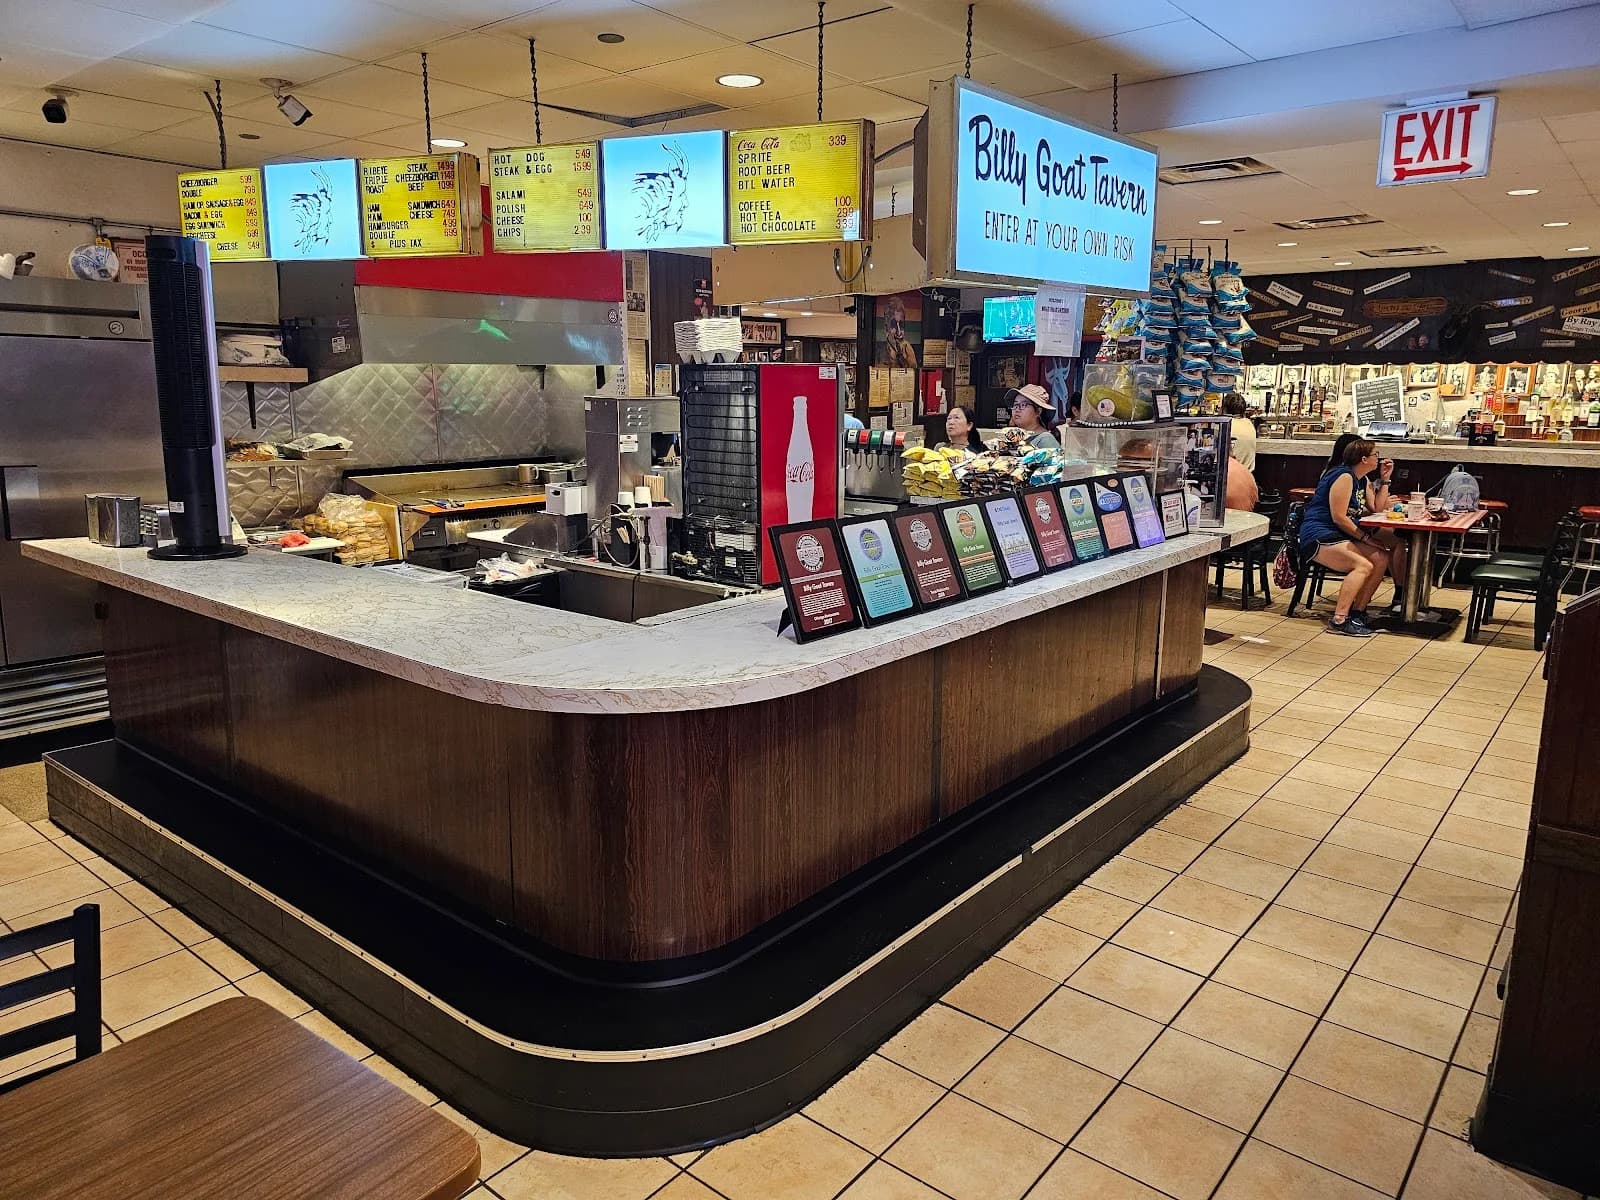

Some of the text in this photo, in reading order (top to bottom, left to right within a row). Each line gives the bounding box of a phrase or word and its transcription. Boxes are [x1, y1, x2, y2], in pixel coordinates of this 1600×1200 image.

[828, 134, 846, 146] 339
[1394, 104, 1480, 165] EXIT
[494, 149, 590, 164] HOT DOG 549
[738, 152, 772, 164] SPRITE
[364, 161, 454, 176] RIBEYE STEAK 1499
[494, 162, 592, 176] STEAK & EGG 1599
[738, 164, 790, 176] ROOT BEER
[968, 114, 1148, 216] Billy Goat Tavern
[364, 176, 388, 184] TRIPLE
[738, 177, 795, 190] BTL WATER
[366, 185, 384, 194] ROAST
[408, 182, 424, 192] BEEF
[496, 188, 592, 200] SALAMI 549
[367, 204, 380, 212] HAM
[408, 201, 440, 210] SANDWICH
[496, 204, 526, 214] POLISH
[739, 196, 852, 212] COFFEE 100
[368, 212, 382, 222] HAM
[410, 210, 434, 220] CHEESE
[496, 213, 592, 226] CHEESE 100
[740, 212, 756, 222] HOT
[764, 211, 781, 220] TEA
[368, 221, 408, 230] HAMBURGER
[742, 222, 757, 232] HOT
[762, 220, 816, 232] CHOCOLATE
[370, 231, 396, 240] DOUBLE
[498, 228, 520, 237] CHIPS
[985, 210, 1135, 262] ENTER AT YOUR OWN RISK
[217, 242, 238, 250] CHEESE
[390, 240, 406, 248] PLUS
[410, 239, 422, 248] TAX
[1562, 306, 1592, 316] George
[1580, 318, 1598, 327] Ray
